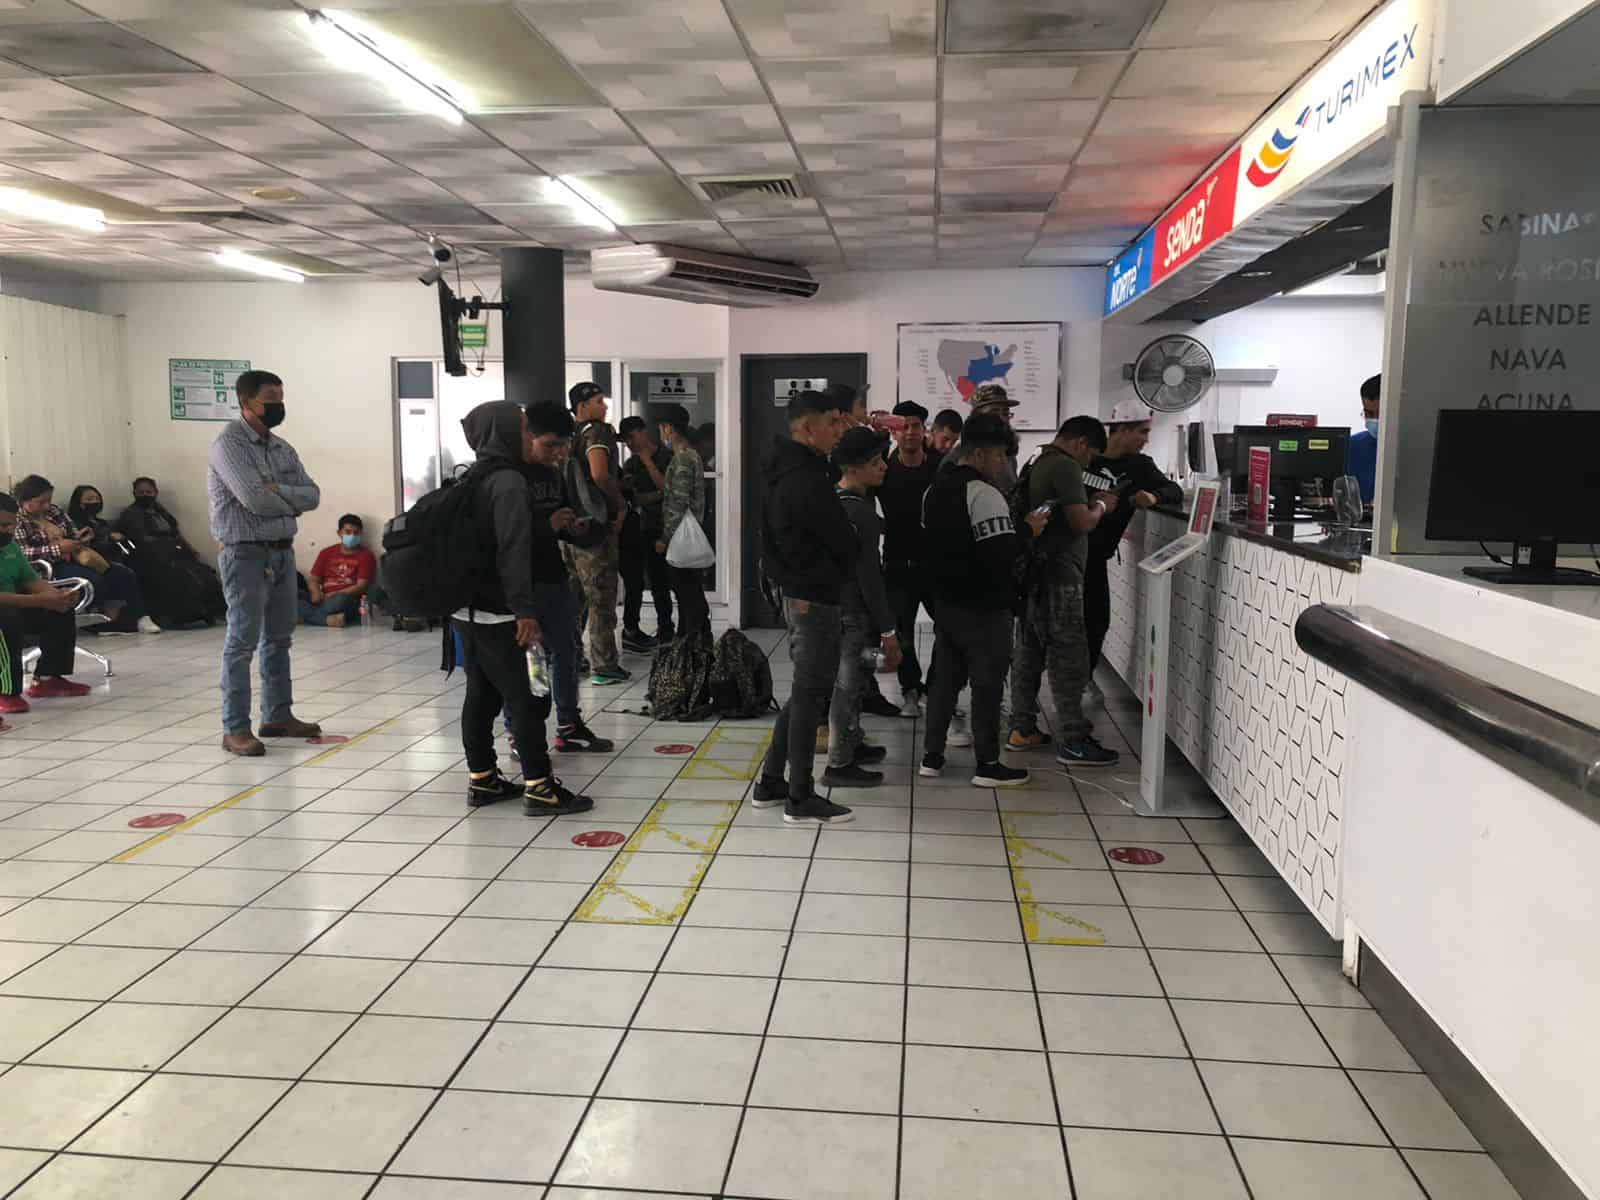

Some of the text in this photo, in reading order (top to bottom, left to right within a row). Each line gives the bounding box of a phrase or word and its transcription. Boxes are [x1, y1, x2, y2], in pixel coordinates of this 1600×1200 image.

[1315, 23, 1418, 133] TURIMEX
[1473, 303, 1592, 326] ALLENDE
[1489, 349, 1567, 371] NAVA
[1082, 471, 1112, 490] UMA
